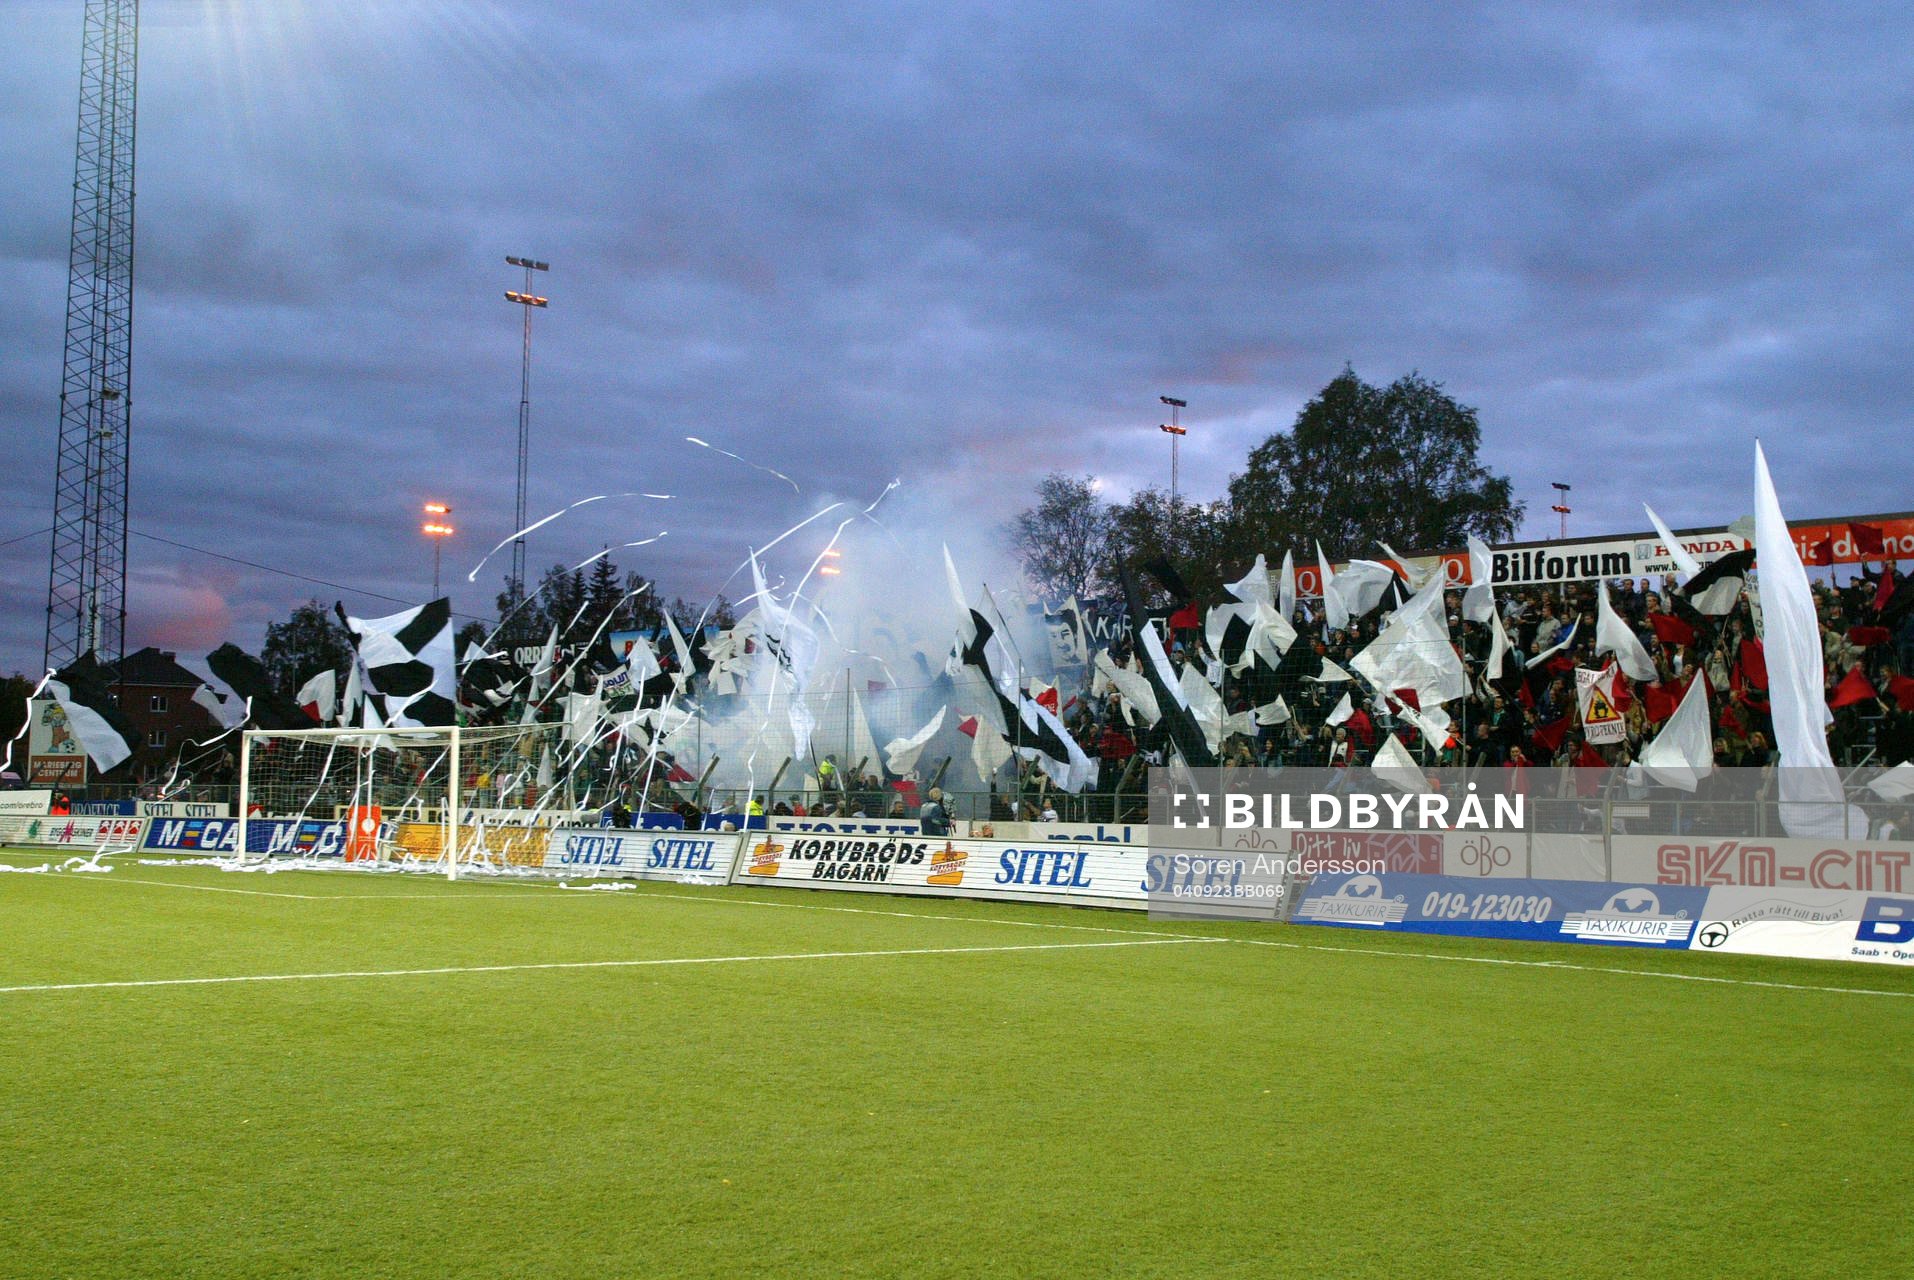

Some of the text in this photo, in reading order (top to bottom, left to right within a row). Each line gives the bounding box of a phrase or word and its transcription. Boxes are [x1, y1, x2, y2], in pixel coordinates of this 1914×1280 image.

[1655, 539, 1738, 557] HNDA
[1491, 550, 1632, 583] Bilforum
[561, 836, 624, 866] SITEL
[647, 839, 716, 871] SITEL
[789, 837, 928, 865] KORVBRÖDS
[1296, 833, 1362, 859] Ditt liv
[1461, 835, 1511, 876] ÖBO
[812, 862, 890, 882] BAGARN
[995, 848, 1092, 888] SITEL
[1319, 901, 1387, 919] TAXIKURIR
[1421, 891, 1552, 923] 019-123030
[1732, 905, 1844, 928] Ratta rätt till Biva!
[1585, 918, 1668, 936] TAXIKURIR
[1851, 946, 1880, 957] Saab
